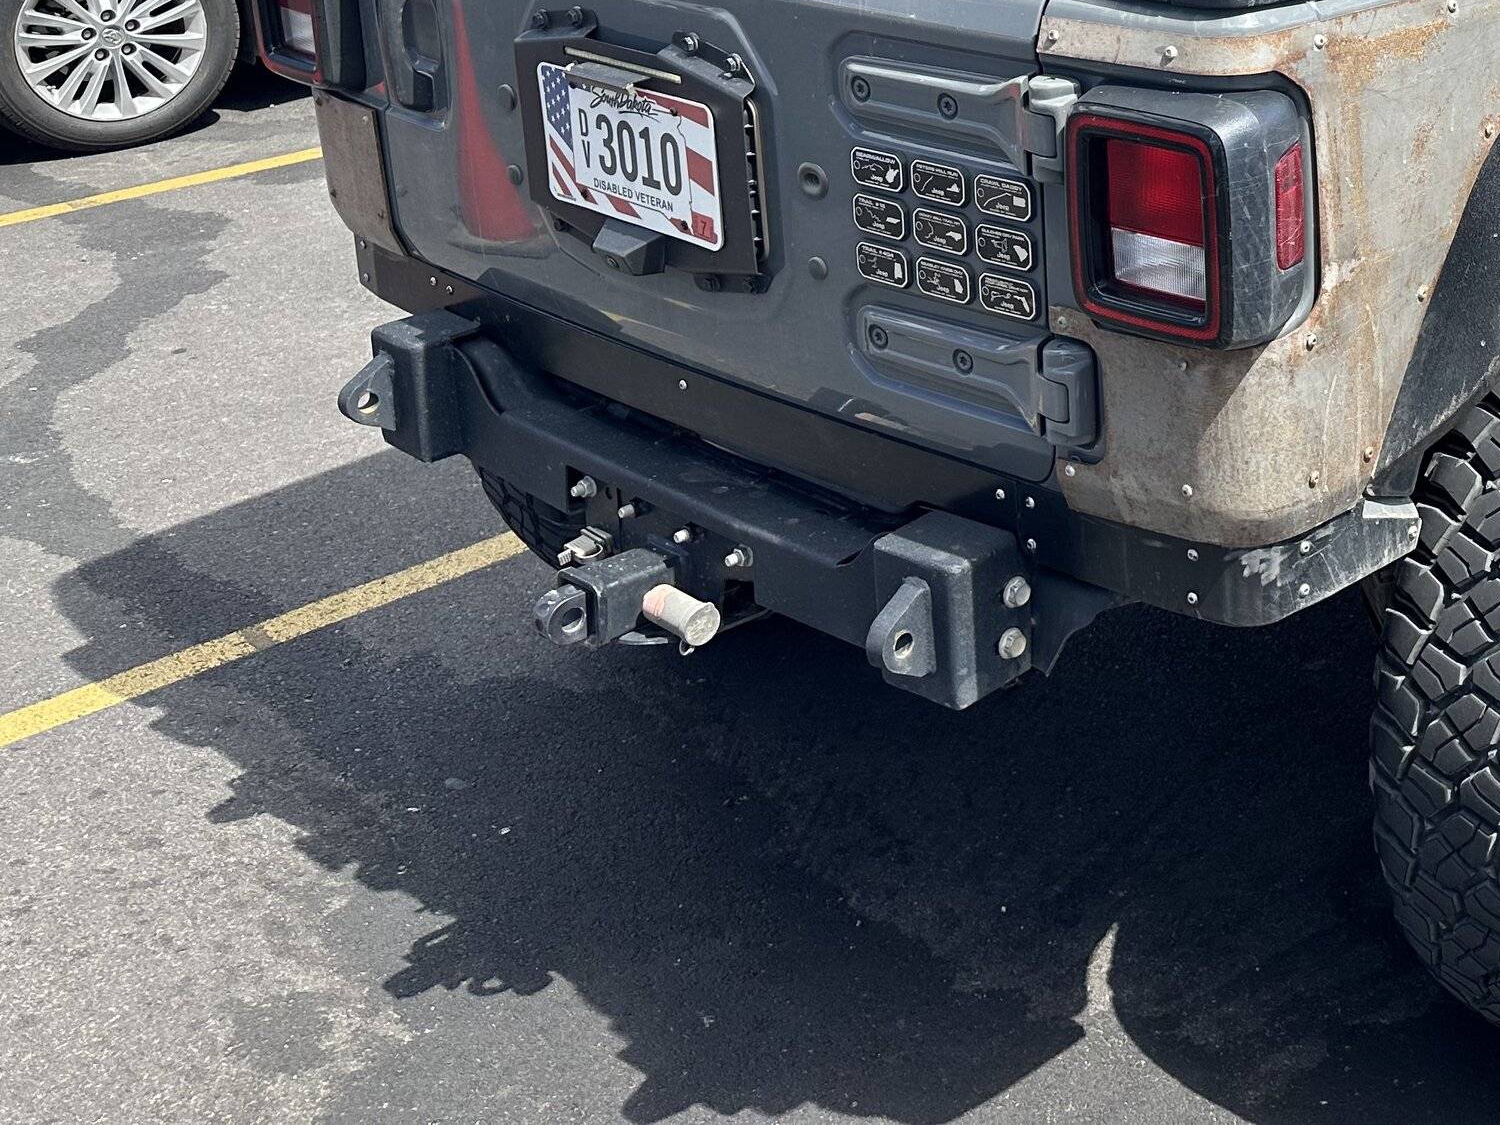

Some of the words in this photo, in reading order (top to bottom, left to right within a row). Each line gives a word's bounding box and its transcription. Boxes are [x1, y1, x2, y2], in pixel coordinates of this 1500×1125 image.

[595, 113, 682, 196] 3010
[593, 177, 633, 199] DISABLED
[635, 191, 674, 212] VETERAN
[931, 187, 945, 196] Jeep
[995, 202, 1010, 211] Jeep
[872, 221, 885, 230] Jeep
[933, 235, 947, 245] Jeep
[876, 268, 889, 277] Jeep
[936, 283, 950, 294] Jeep
